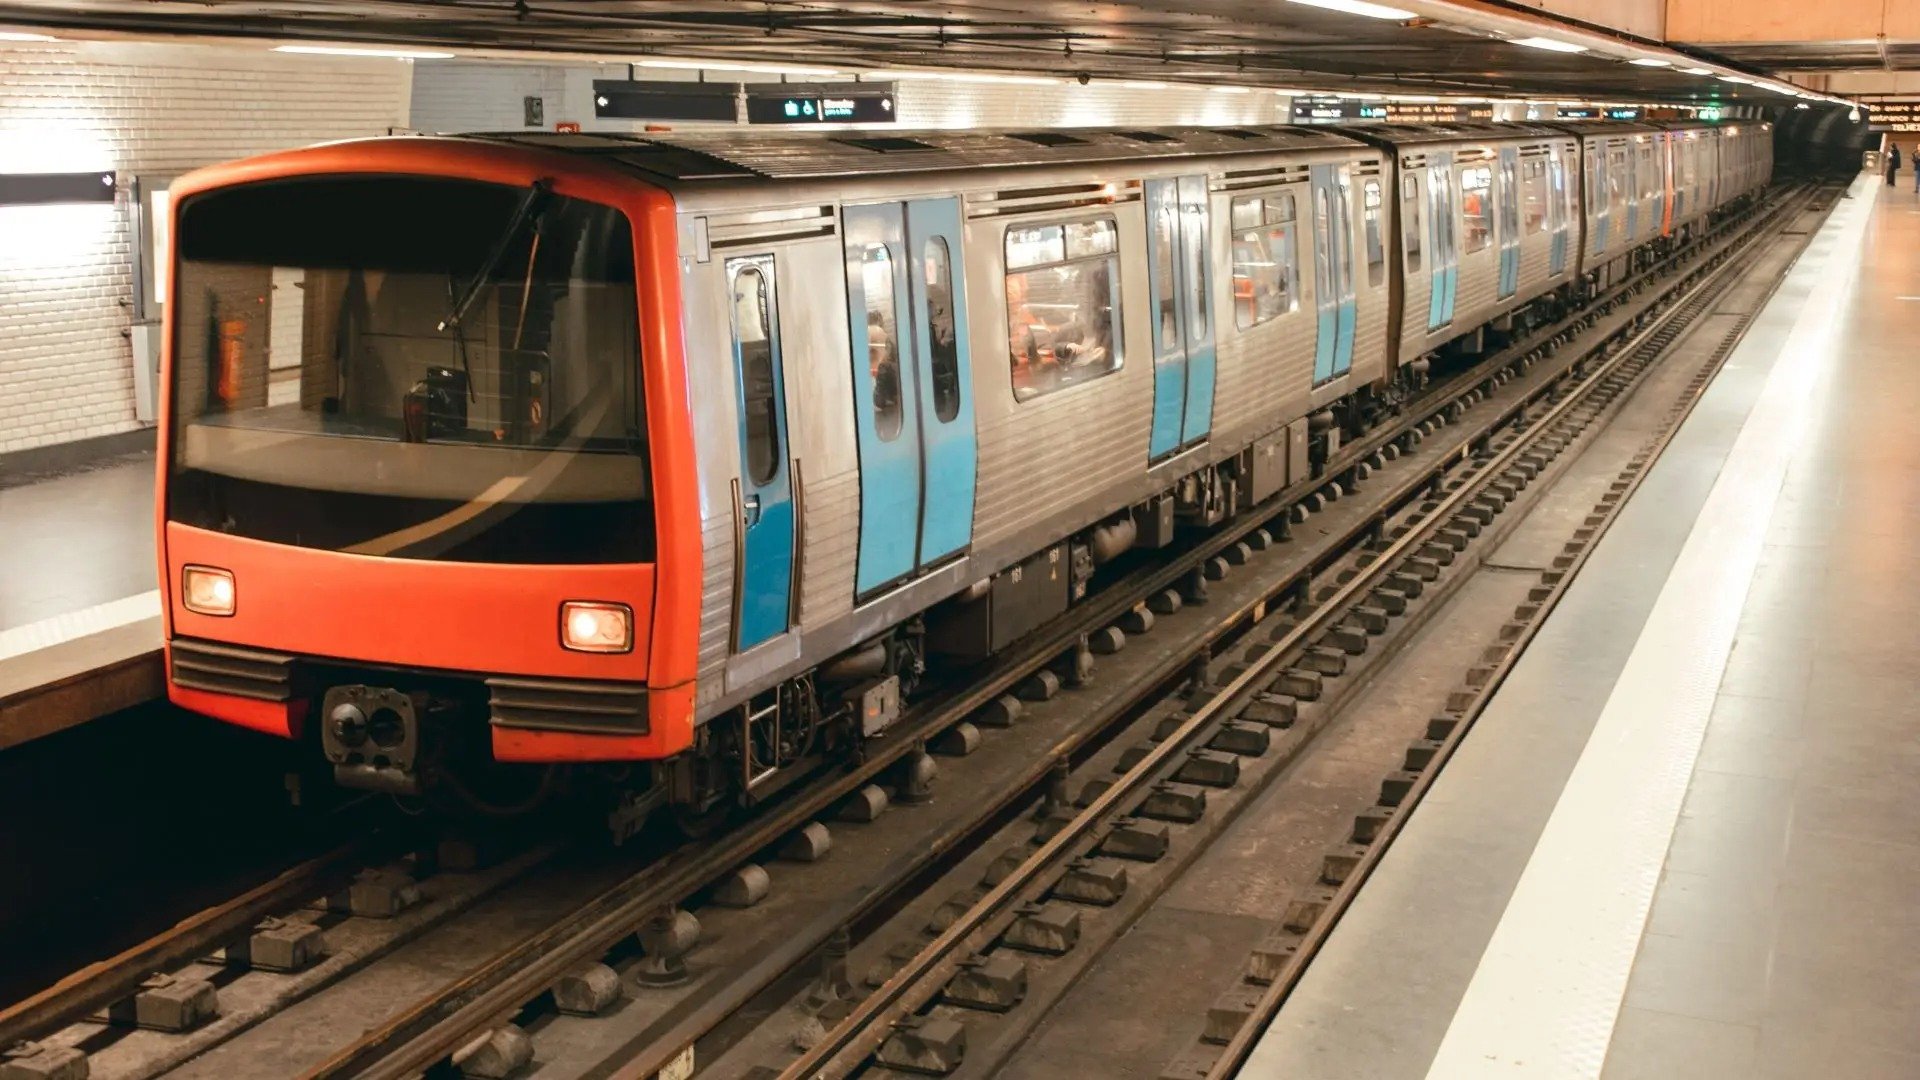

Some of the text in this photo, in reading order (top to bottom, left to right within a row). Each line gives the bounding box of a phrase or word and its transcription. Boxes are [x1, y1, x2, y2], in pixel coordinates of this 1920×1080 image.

[1869, 104, 1881, 112] Be
[1386, 114, 1419, 122] entrance
[1869, 114, 1909, 122] entrance
